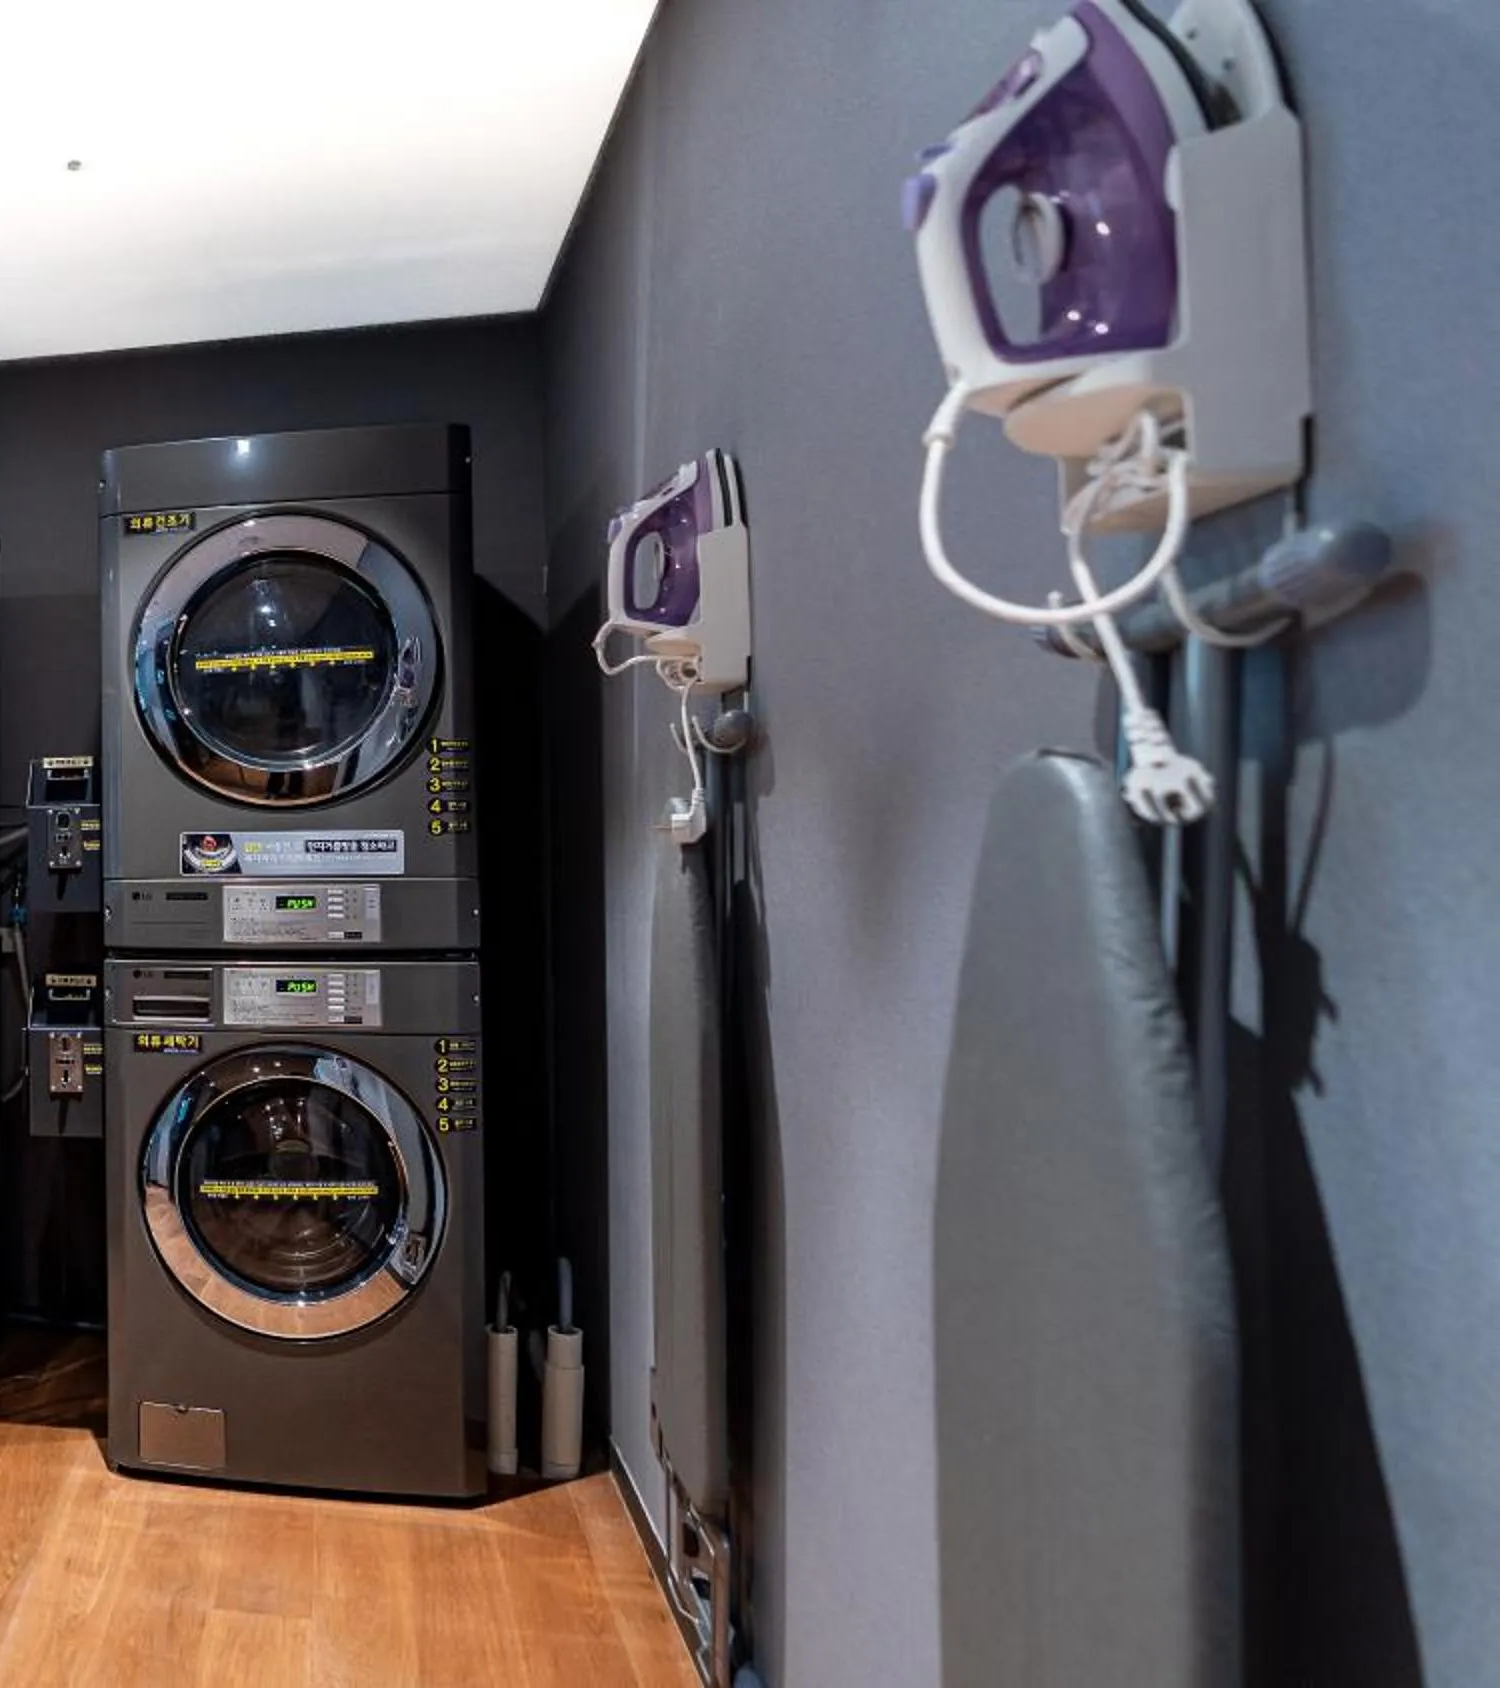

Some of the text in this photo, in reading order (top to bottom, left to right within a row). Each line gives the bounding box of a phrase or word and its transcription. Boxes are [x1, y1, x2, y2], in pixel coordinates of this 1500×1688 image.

[429, 757, 441, 771] 2
[429, 777, 441, 792] 3
[430, 799, 442, 813] 4
[431, 819, 441, 835] 5
[138, 1034, 199, 1048] 의류세탁기
[437, 1059, 448, 1073] 2
[438, 1077, 449, 1091] 3
[437, 1097, 449, 1111] 4
[439, 1118, 449, 1132] 5
